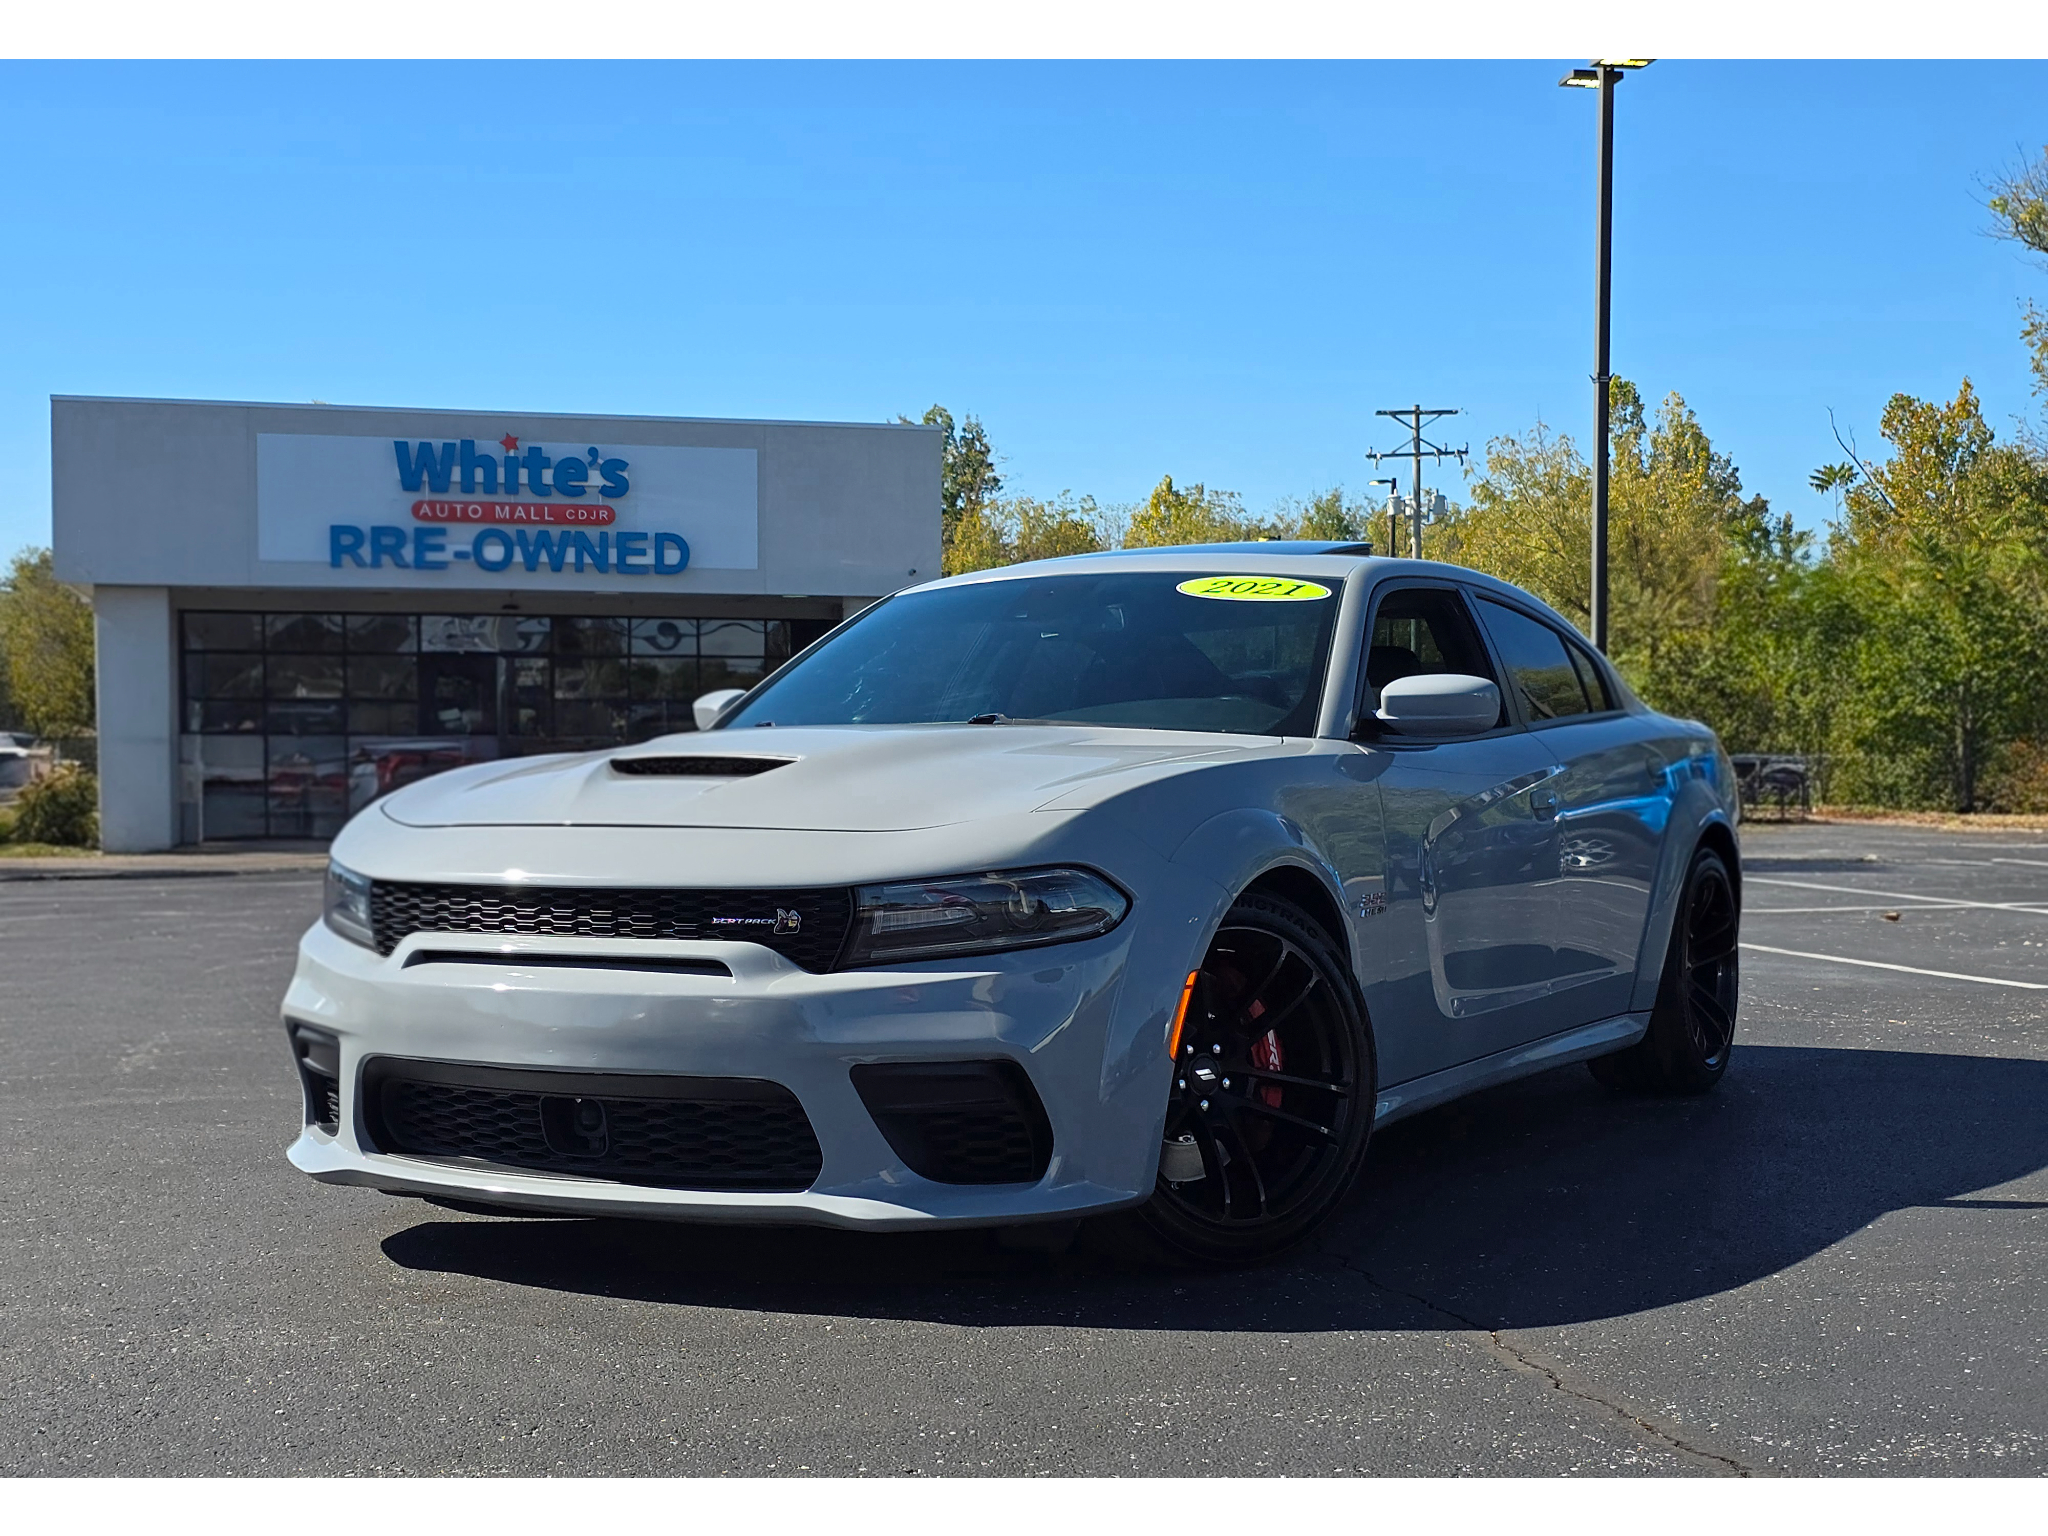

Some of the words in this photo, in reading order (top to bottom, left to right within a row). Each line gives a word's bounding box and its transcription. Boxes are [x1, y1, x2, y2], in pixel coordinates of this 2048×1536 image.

[394, 434, 630, 499] White's
[418, 503, 482, 519] AUTO
[494, 505, 554, 521] MALL
[565, 509, 609, 521] CDJR
[1202, 581, 1305, 596] 2021
